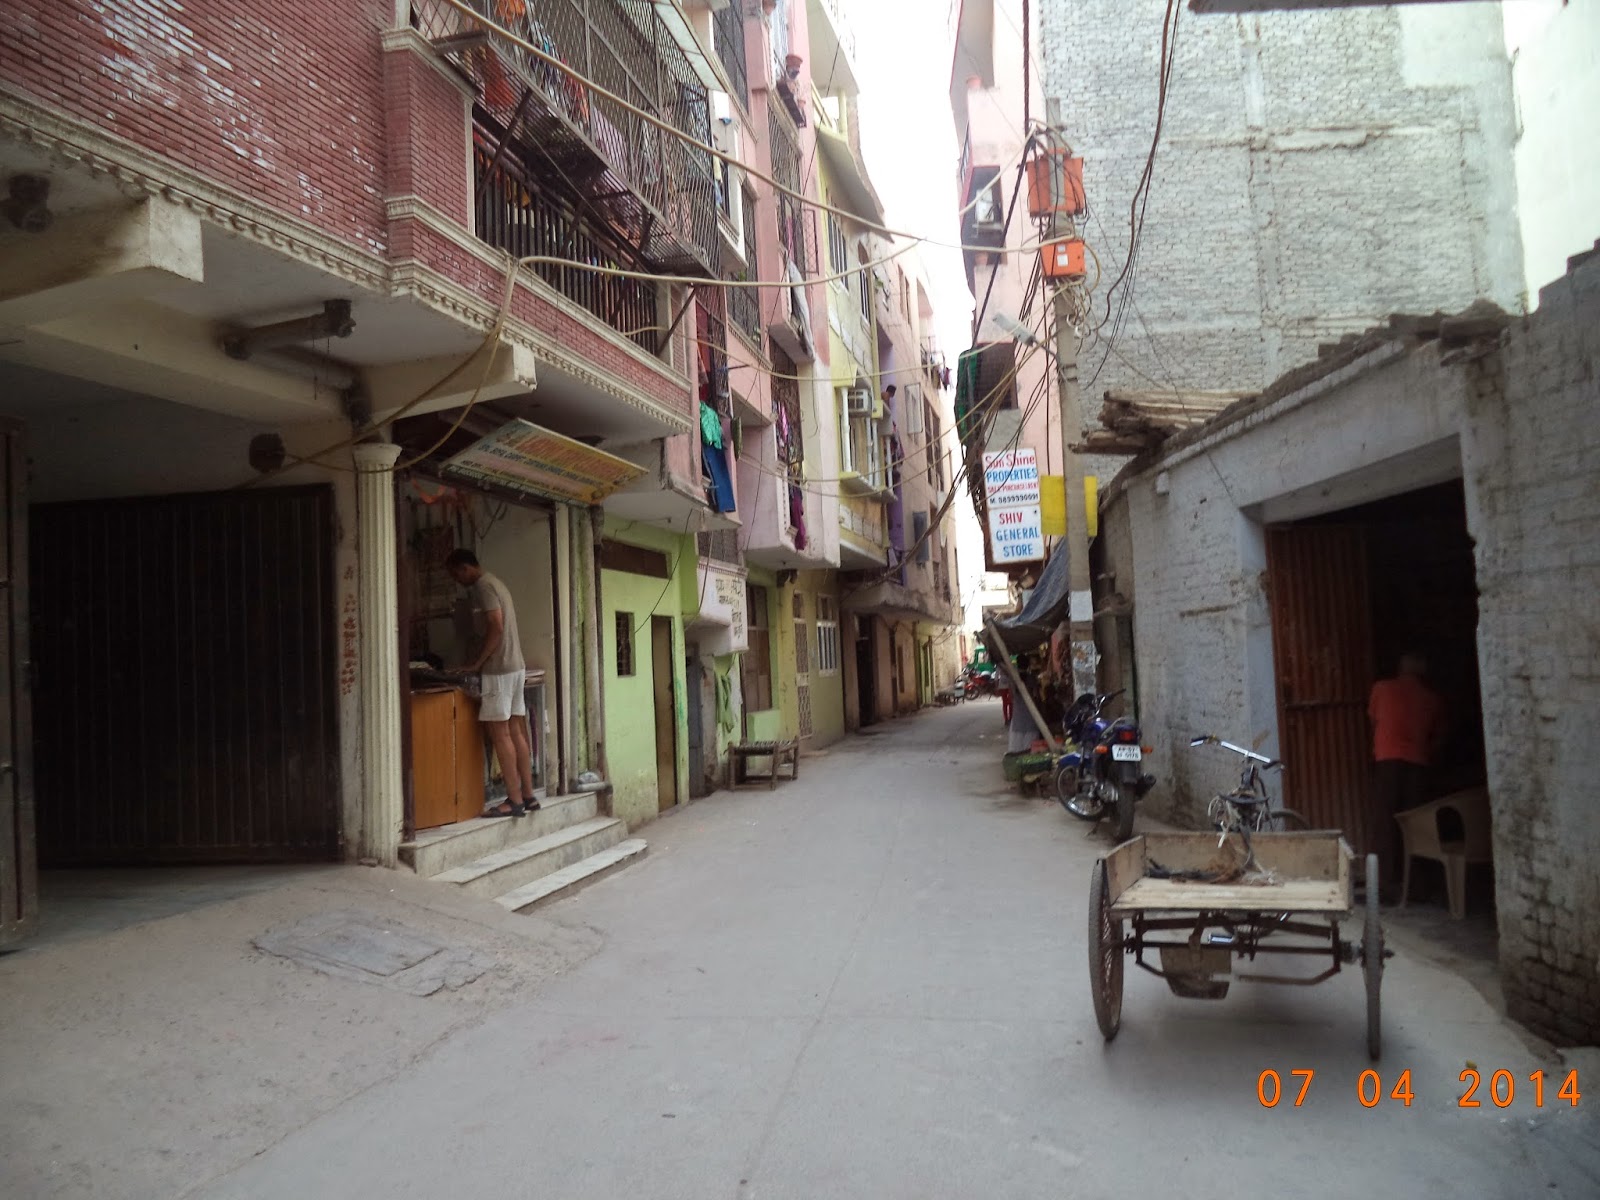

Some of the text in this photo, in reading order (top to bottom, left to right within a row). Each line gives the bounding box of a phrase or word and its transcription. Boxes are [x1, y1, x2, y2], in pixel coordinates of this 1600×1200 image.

[985, 453, 1035, 468] Sun Shine
[986, 467, 1038, 482] PROPERTIES
[999, 512, 1023, 525] SHIV
[996, 527, 1039, 542] GENERAL
[1003, 544, 1033, 558] STORE
